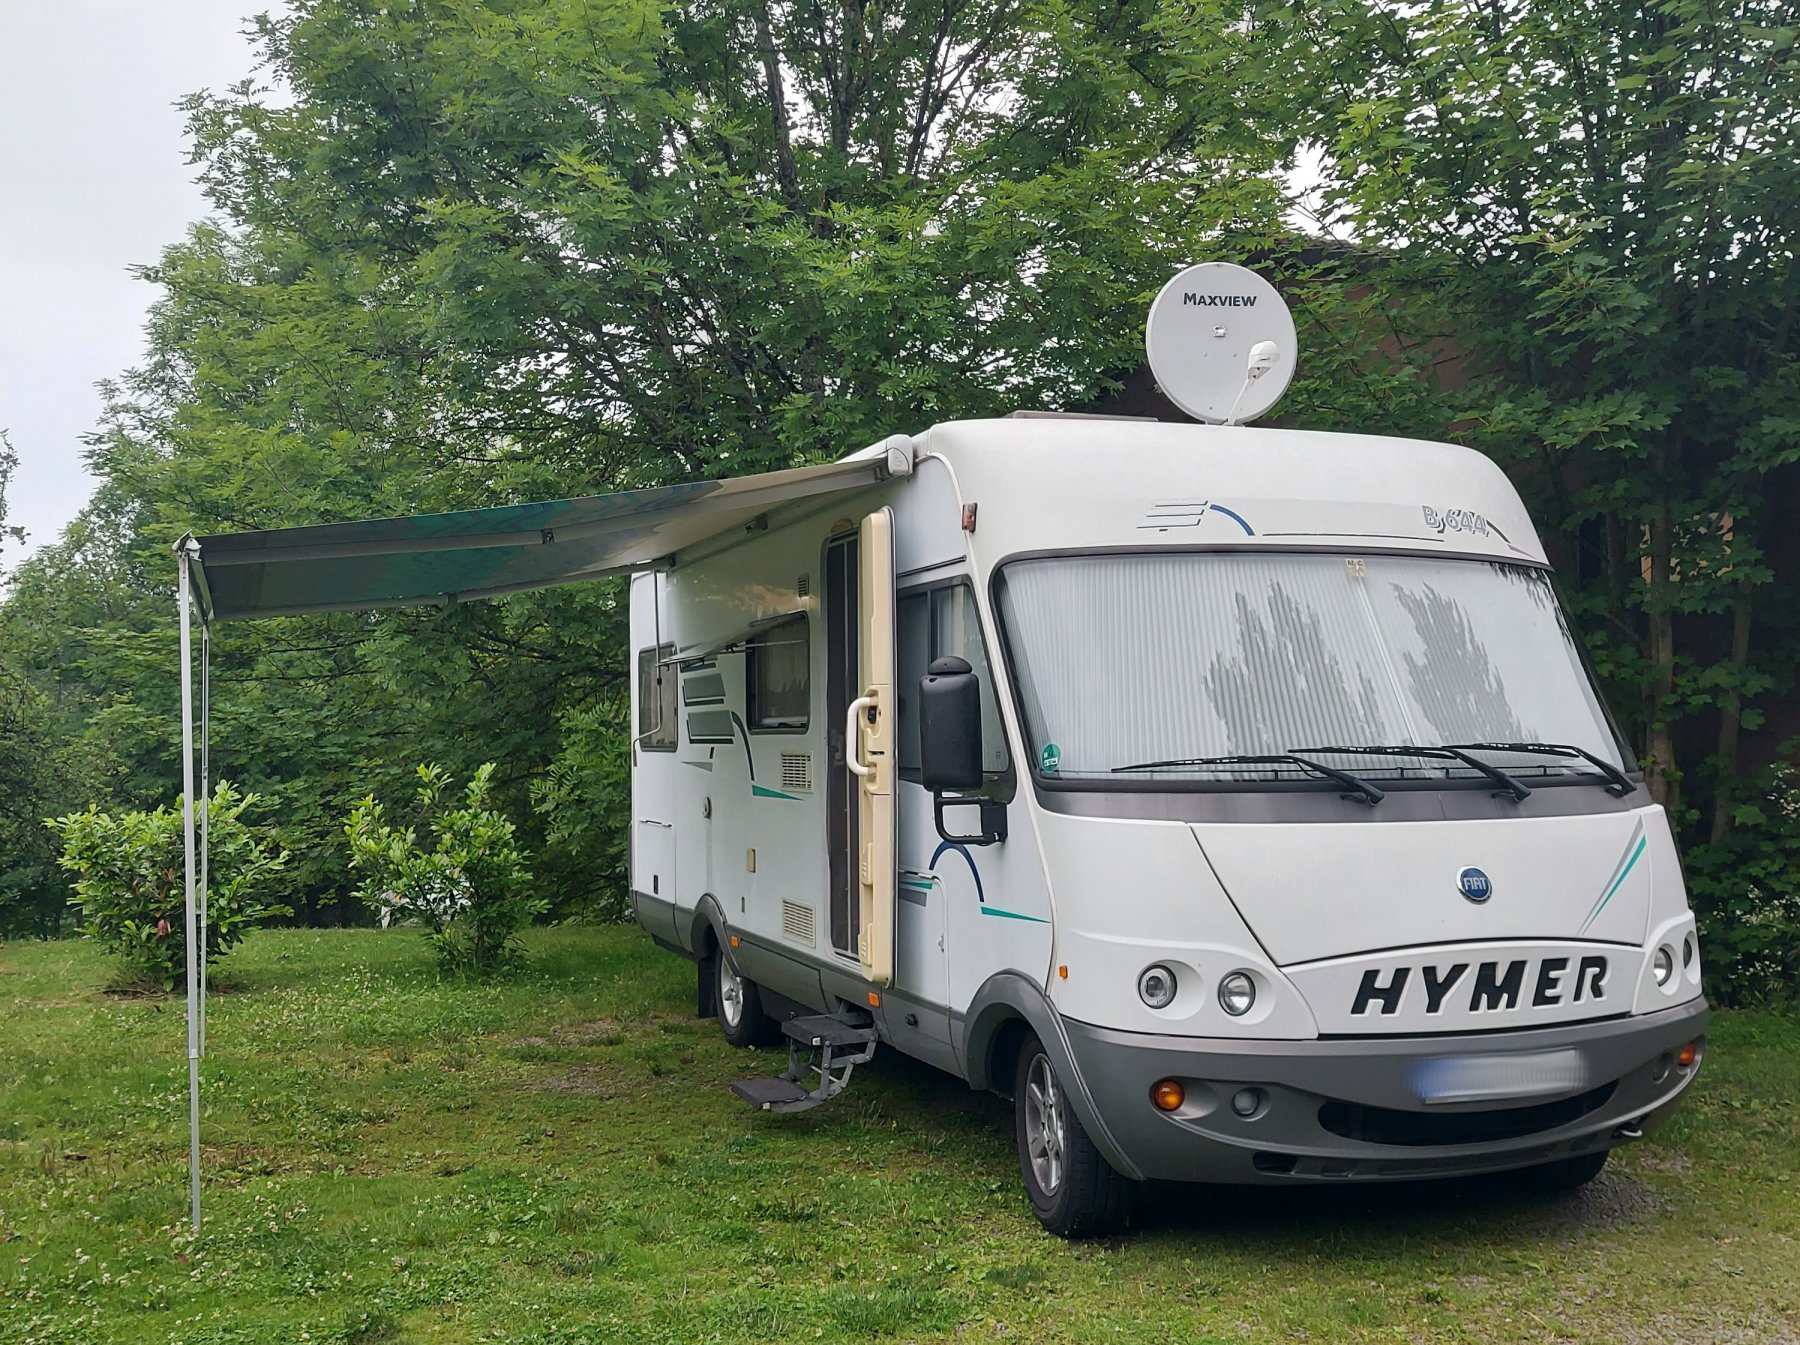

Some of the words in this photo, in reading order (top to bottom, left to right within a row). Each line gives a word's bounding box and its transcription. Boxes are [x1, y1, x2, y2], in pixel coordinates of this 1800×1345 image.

[1183, 292, 1257, 307] MAXVIEW
[1422, 505, 1441, 530] B
[1445, 509, 1489, 537] 644
[1463, 877, 1487, 890] FIAT
[1350, 955, 1608, 1015] HYMER
